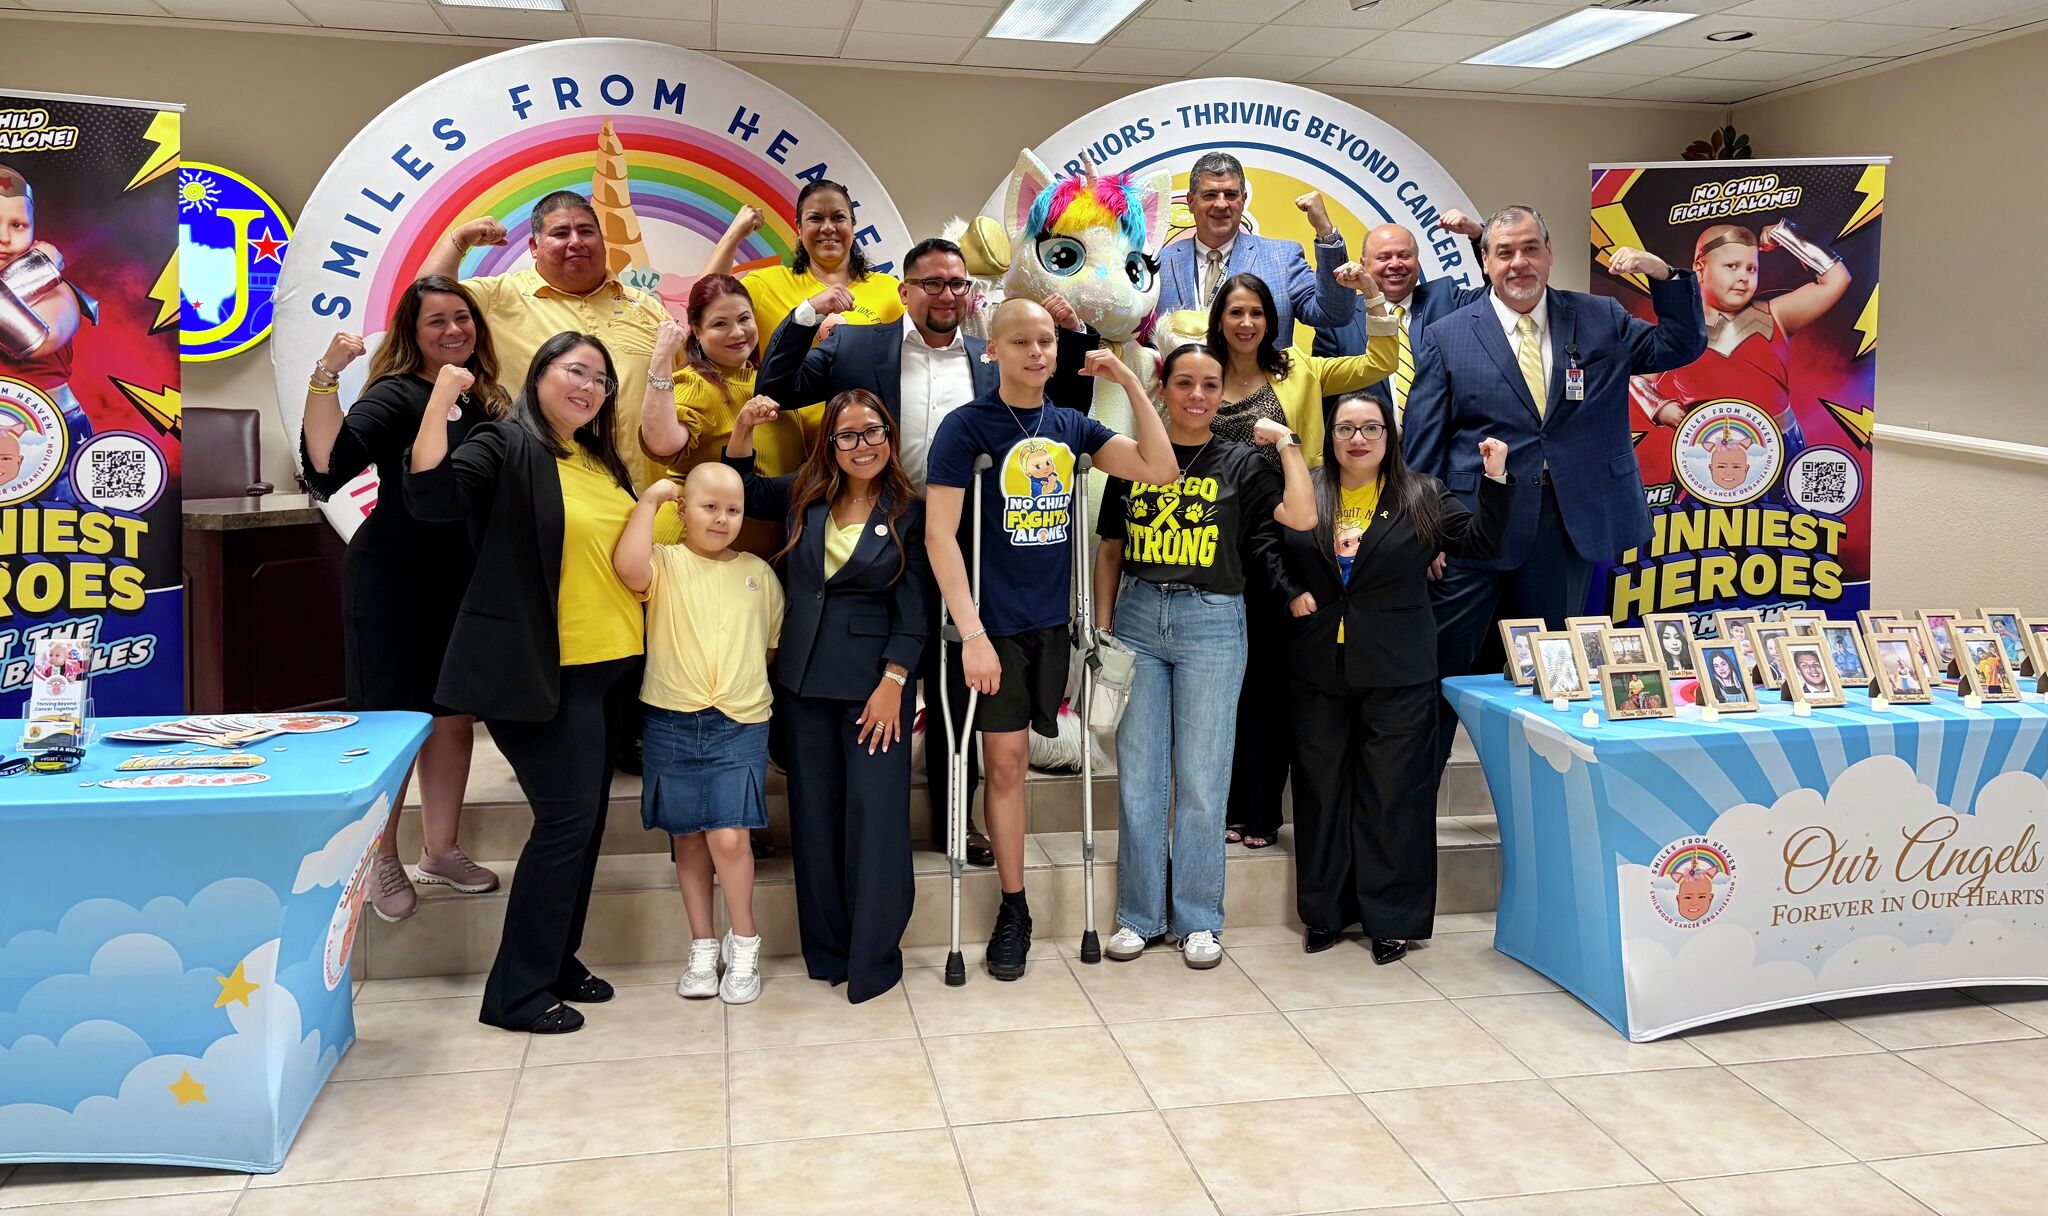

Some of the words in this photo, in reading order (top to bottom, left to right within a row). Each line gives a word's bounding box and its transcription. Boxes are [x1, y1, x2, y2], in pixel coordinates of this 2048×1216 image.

[312, 118, 466, 320] SMILES
[508, 74, 687, 120] FROM
[727, 105, 895, 277] HEAE
[1176, 102, 1301, 132] THRIVING
[1304, 115, 1400, 184] BEYOND
[1396, 181, 1463, 272] CANCER
[1672, 200, 1731, 220] FIGHTS
[1733, 190, 1799, 212] ALONE!
[1694, 185, 1719, 202] NO
[1724, 177, 1775, 197] CHILD
[16, 392, 53, 430] HEAVEN
[1682, 414, 1707, 445] SMILES
[1712, 407, 1741, 415] FROM
[1745, 412, 1773, 444] HEAVEN
[12, 442, 54, 492] ORGANIZATION
[1681, 460, 1707, 492] CHILDHOOD
[1708, 489, 1737, 497] CANCER
[1740, 455, 1773, 495] ORGANIZATION
[1010, 497, 1034, 510] NO
[1036, 495, 1071, 510] CHILD
[1645, 487, 1672, 504] HE
[1623, 508, 1847, 564] INNIEST
[1612, 553, 1844, 625] HEROES
[1651, 845, 1677, 875] SMILES
[1682, 838, 1708, 846] FROM
[1712, 841, 1737, 870] HEAVEN
[1783, 826, 1883, 895] Our
[1895, 815, 2045, 899] Angels
[1650, 890, 1674, 924] CHILDHOOD
[1674, 921, 1700, 929] CANCER
[1702, 881, 1735, 925] ORGANIZATION
[1771, 898, 1875, 927] FOREVER
[1881, 895, 1905, 913] IN
[1911, 888, 1960, 911] OUR
[1965, 886, 2045, 907] HEARTS
